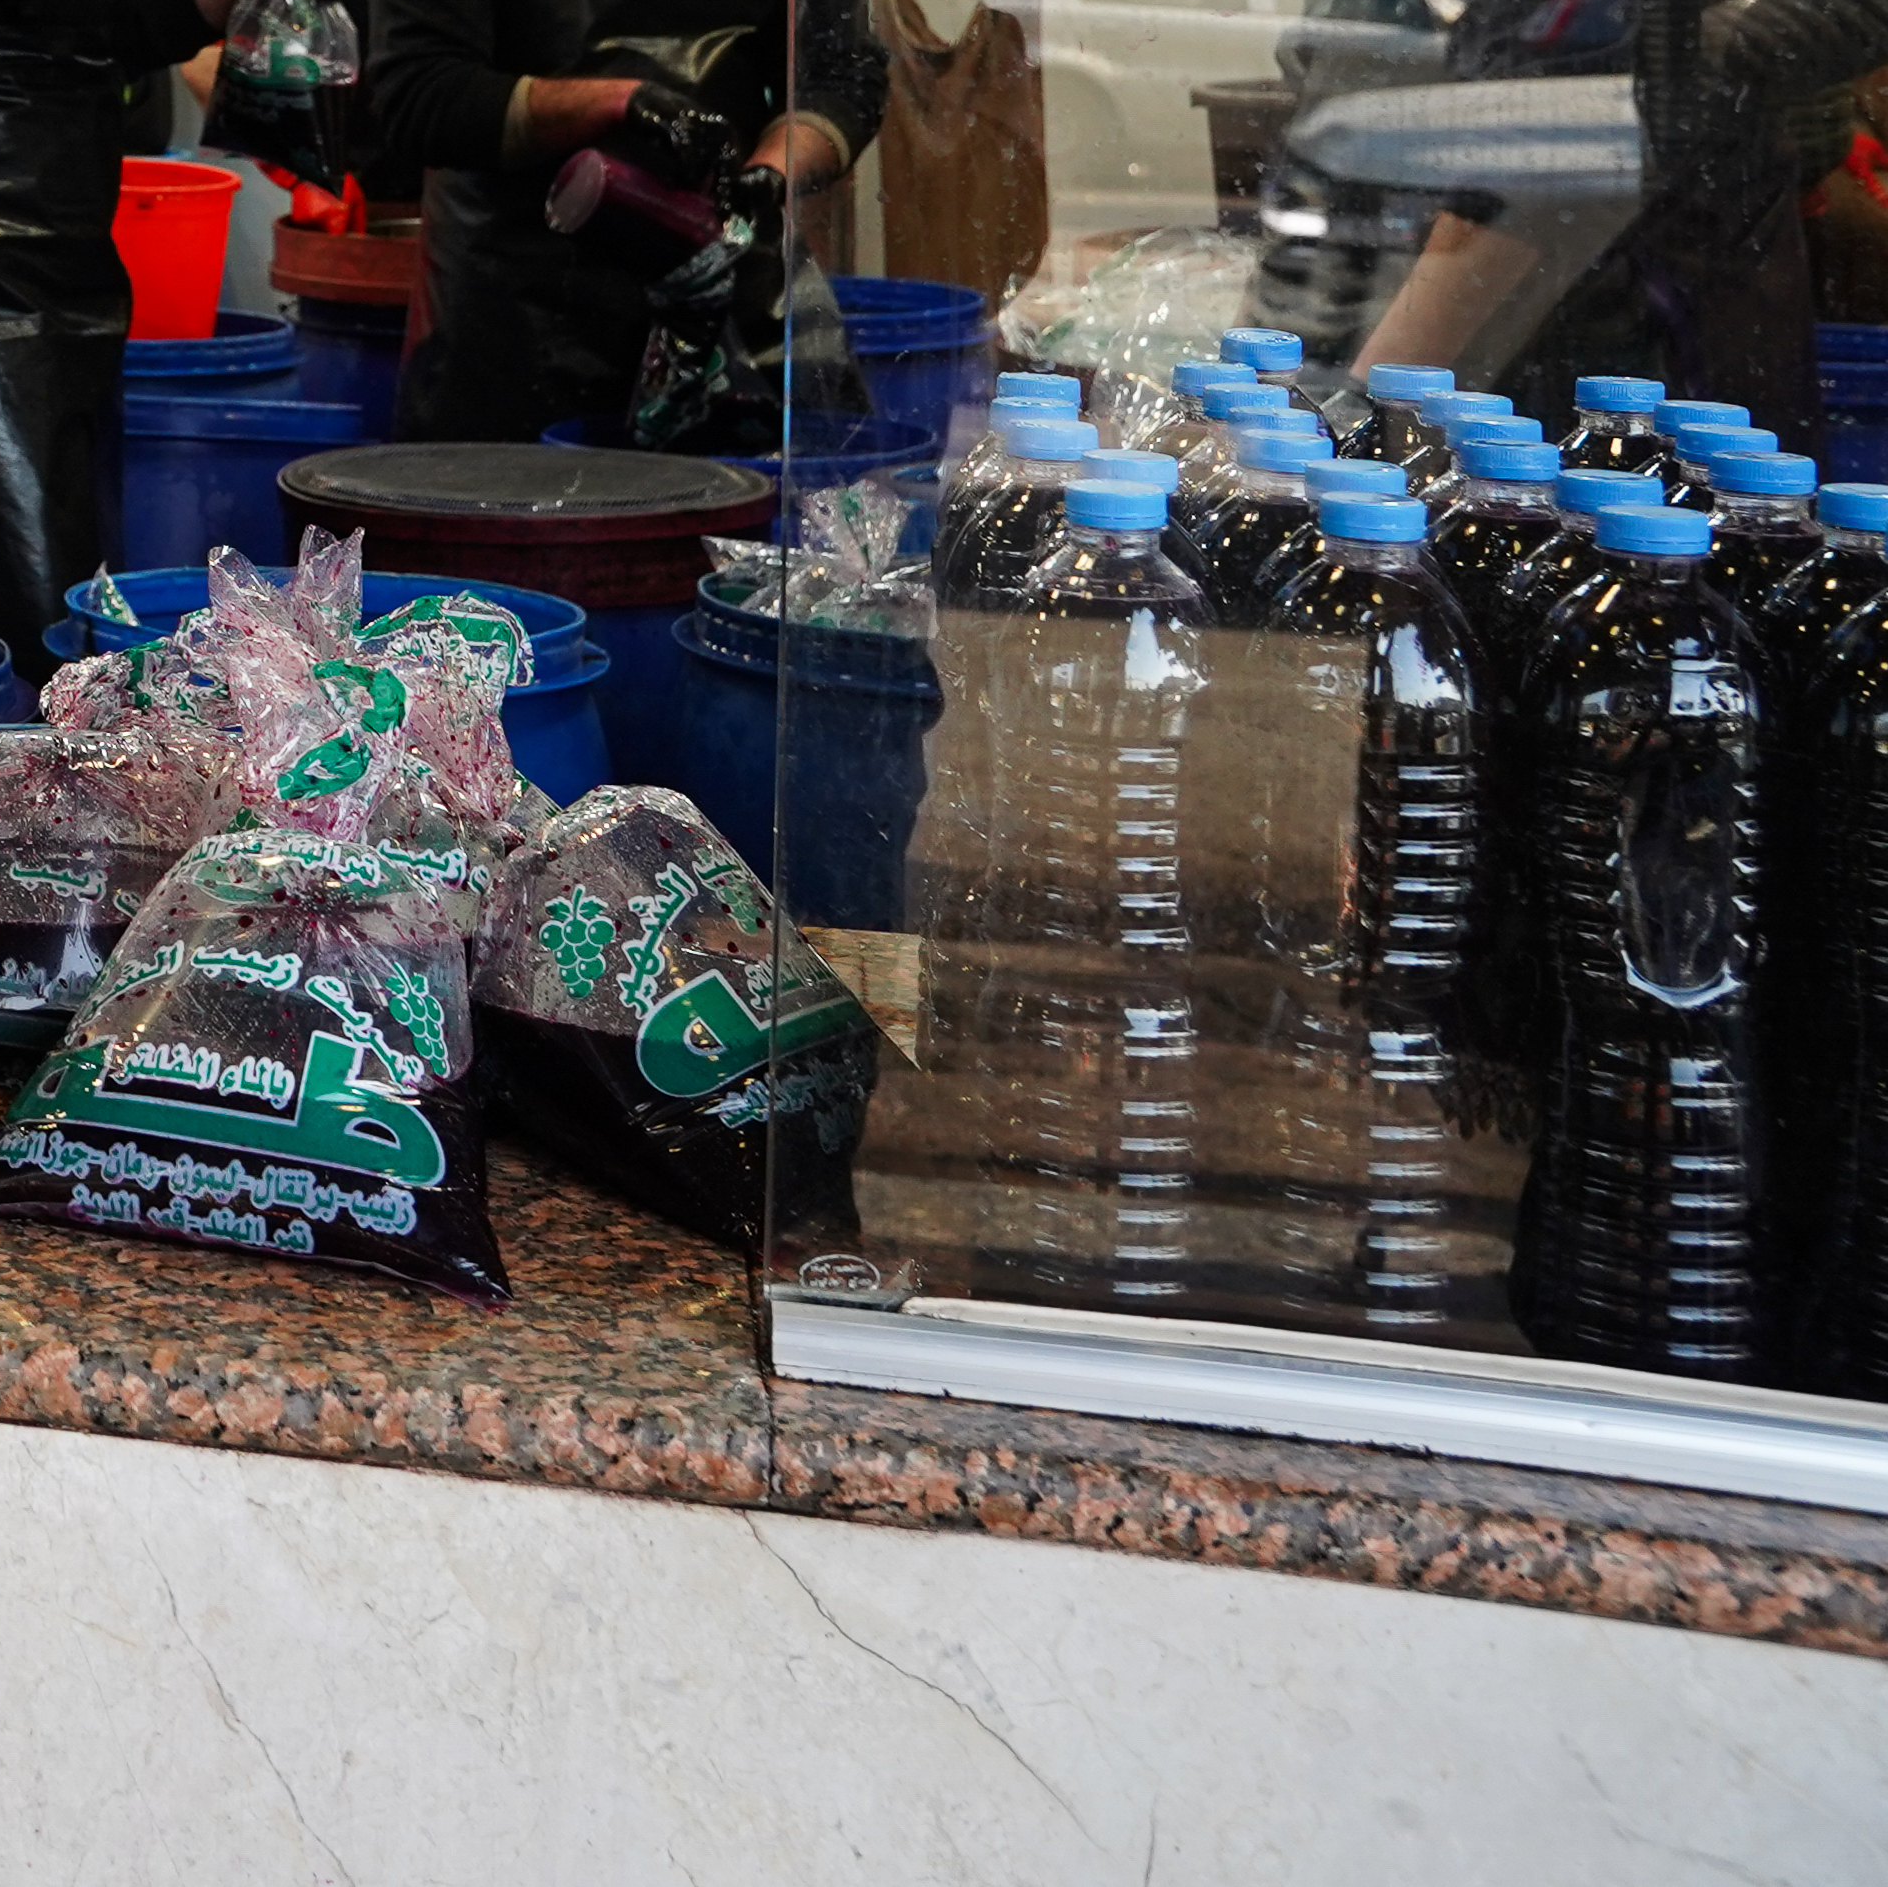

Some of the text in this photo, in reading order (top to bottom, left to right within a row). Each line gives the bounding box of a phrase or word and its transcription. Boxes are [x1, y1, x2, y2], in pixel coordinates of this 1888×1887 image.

[9, 859, 107, 903] زبيب
[377, 839, 467, 889] زبيب
[190, 945, 303, 992] زبيب
[305, 974, 427, 1096] شربت
